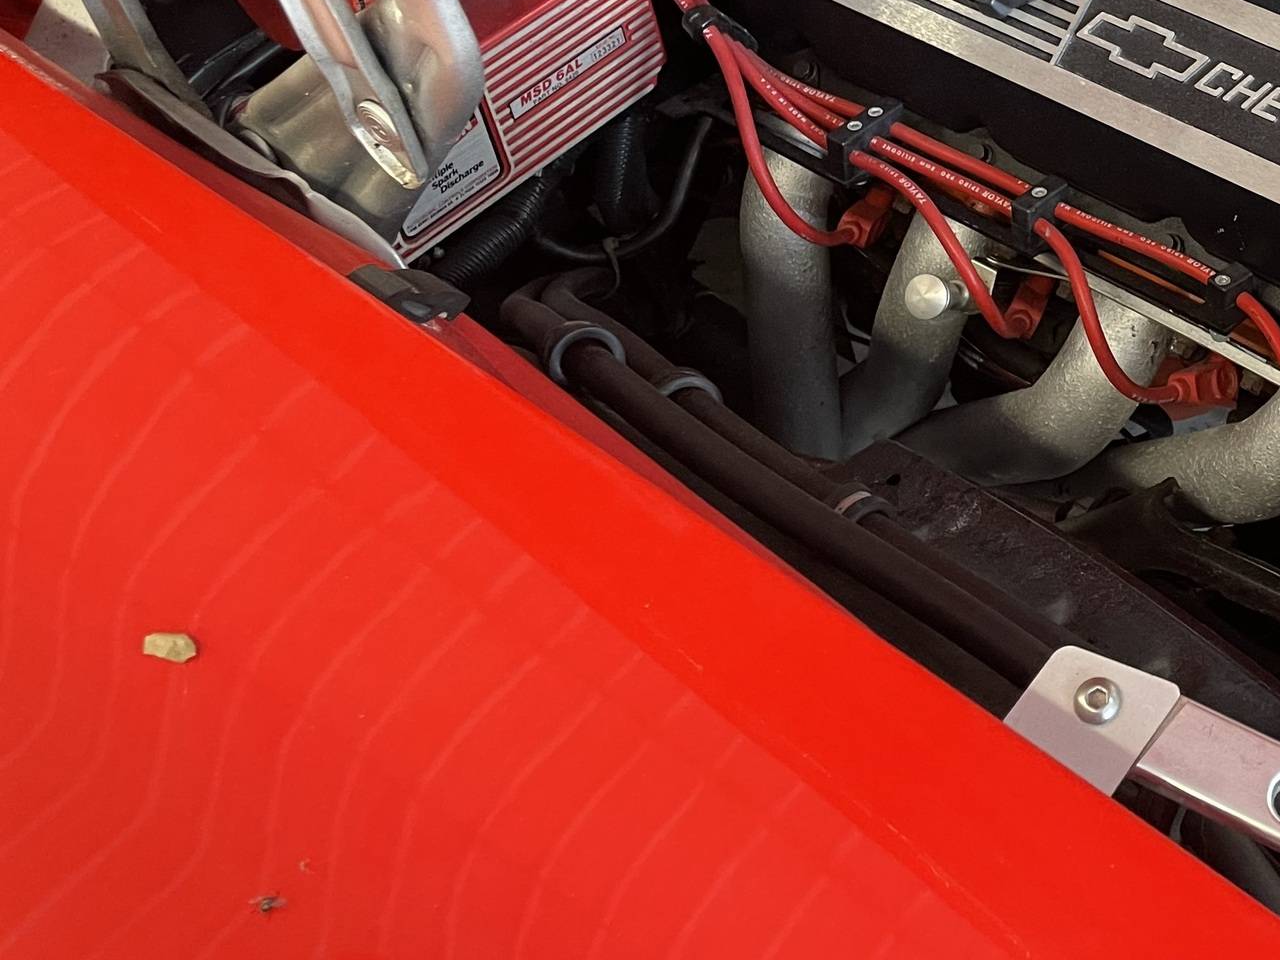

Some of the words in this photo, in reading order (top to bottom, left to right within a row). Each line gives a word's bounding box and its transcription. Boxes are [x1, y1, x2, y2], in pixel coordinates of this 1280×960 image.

[520, 80, 552, 108] MSD
[556, 59, 583, 81] 6AL
[803, 86, 835, 103] TAYLOR
[882, 143, 916, 162] SILICONE
[431, 168, 459, 190] Spark
[440, 160, 484, 194] Discharge
[899, 177, 927, 205] TAYLOR
[1187, 257, 1216, 276] AYLOR
